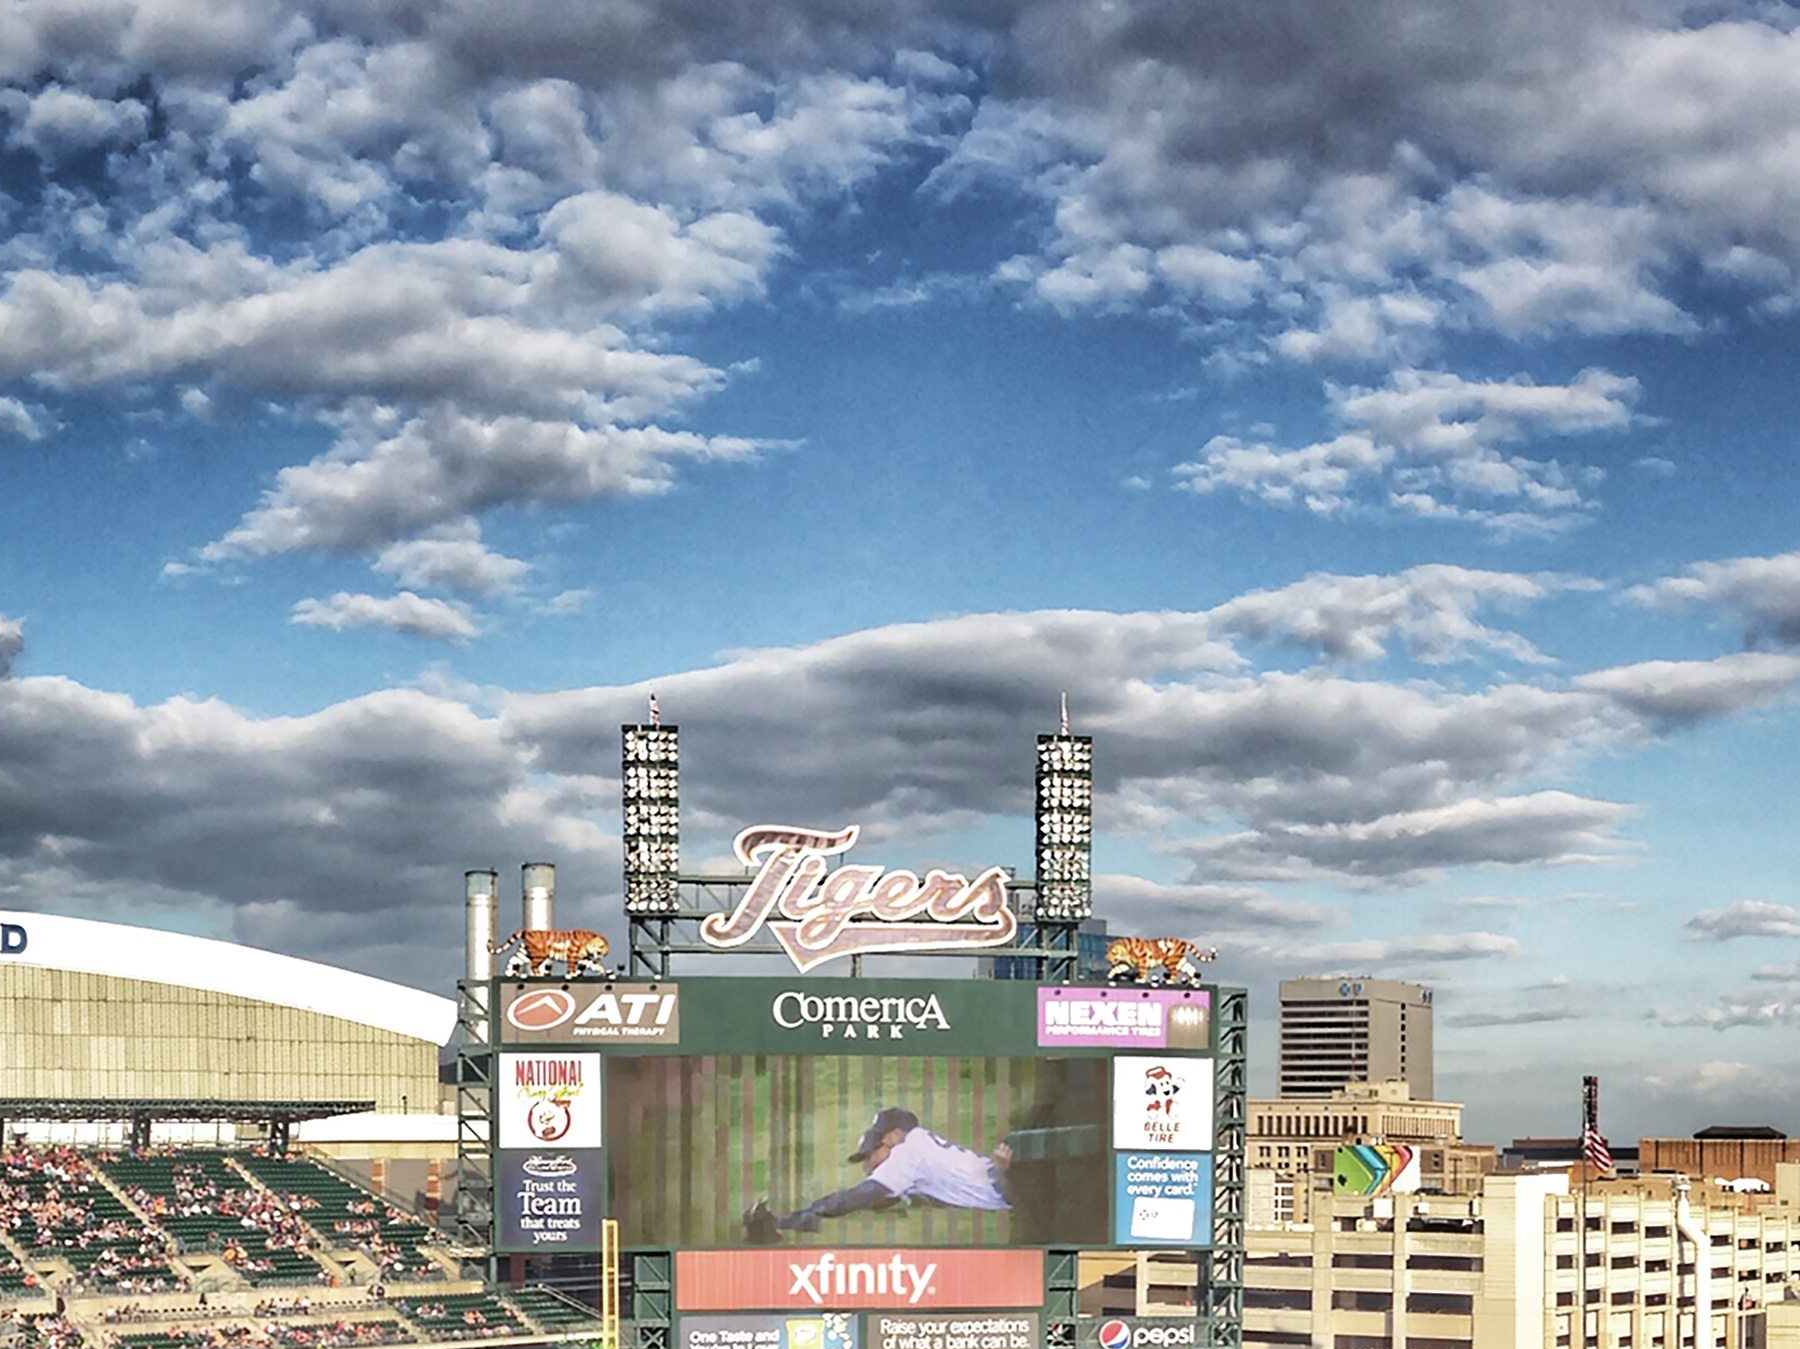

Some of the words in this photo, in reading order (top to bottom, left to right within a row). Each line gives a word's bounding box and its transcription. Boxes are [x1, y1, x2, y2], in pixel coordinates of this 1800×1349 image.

[700, 825, 1017, 973] Tigers
[574, 994, 677, 1024] ATI
[1045, 1000, 1162, 1026] NEXEN
[573, 1027, 620, 1036] PHYSICAL
[622, 1027, 665, 1036] THERAPY
[822, 1025, 903, 1039] PARK
[1045, 1025, 1130, 1037] PERFORMANCE
[1132, 1027, 1161, 1037] TIRES
[1144, 1122, 1181, 1132] BELLE
[1148, 1133, 1175, 1143] TIRE
[1127, 1156, 1198, 1170] Confidence
[1127, 1172, 1168, 1183] comes
[1171, 1169, 1199, 1183] with
[522, 1179, 555, 1193] Trust
[557, 1179, 578, 1193] the
[1127, 1185, 1161, 1198] every
[517, 1191, 582, 1215] Team
[520, 1216, 545, 1230] that
[547, 1217, 582, 1230] treats
[533, 1231, 568, 1244] yours
[789, 1252, 938, 1304] xfinity
[880, 1318, 916, 1334] Raise
[919, 1320, 947, 1339] your
[950, 1318, 1030, 1336] expectations
[689, 1330, 716, 1344] One
[719, 1330, 751, 1344] Taste
[754, 1328, 780, 1344] and
[883, 1334, 897, 1349] of
[898, 1334, 933, 1349] what
[935, 1338, 944, 1349] a
[946, 1333, 980, 1349] bank
[982, 1337, 1007, 1349] can
[1133, 1324, 1195, 1349] pepsi
